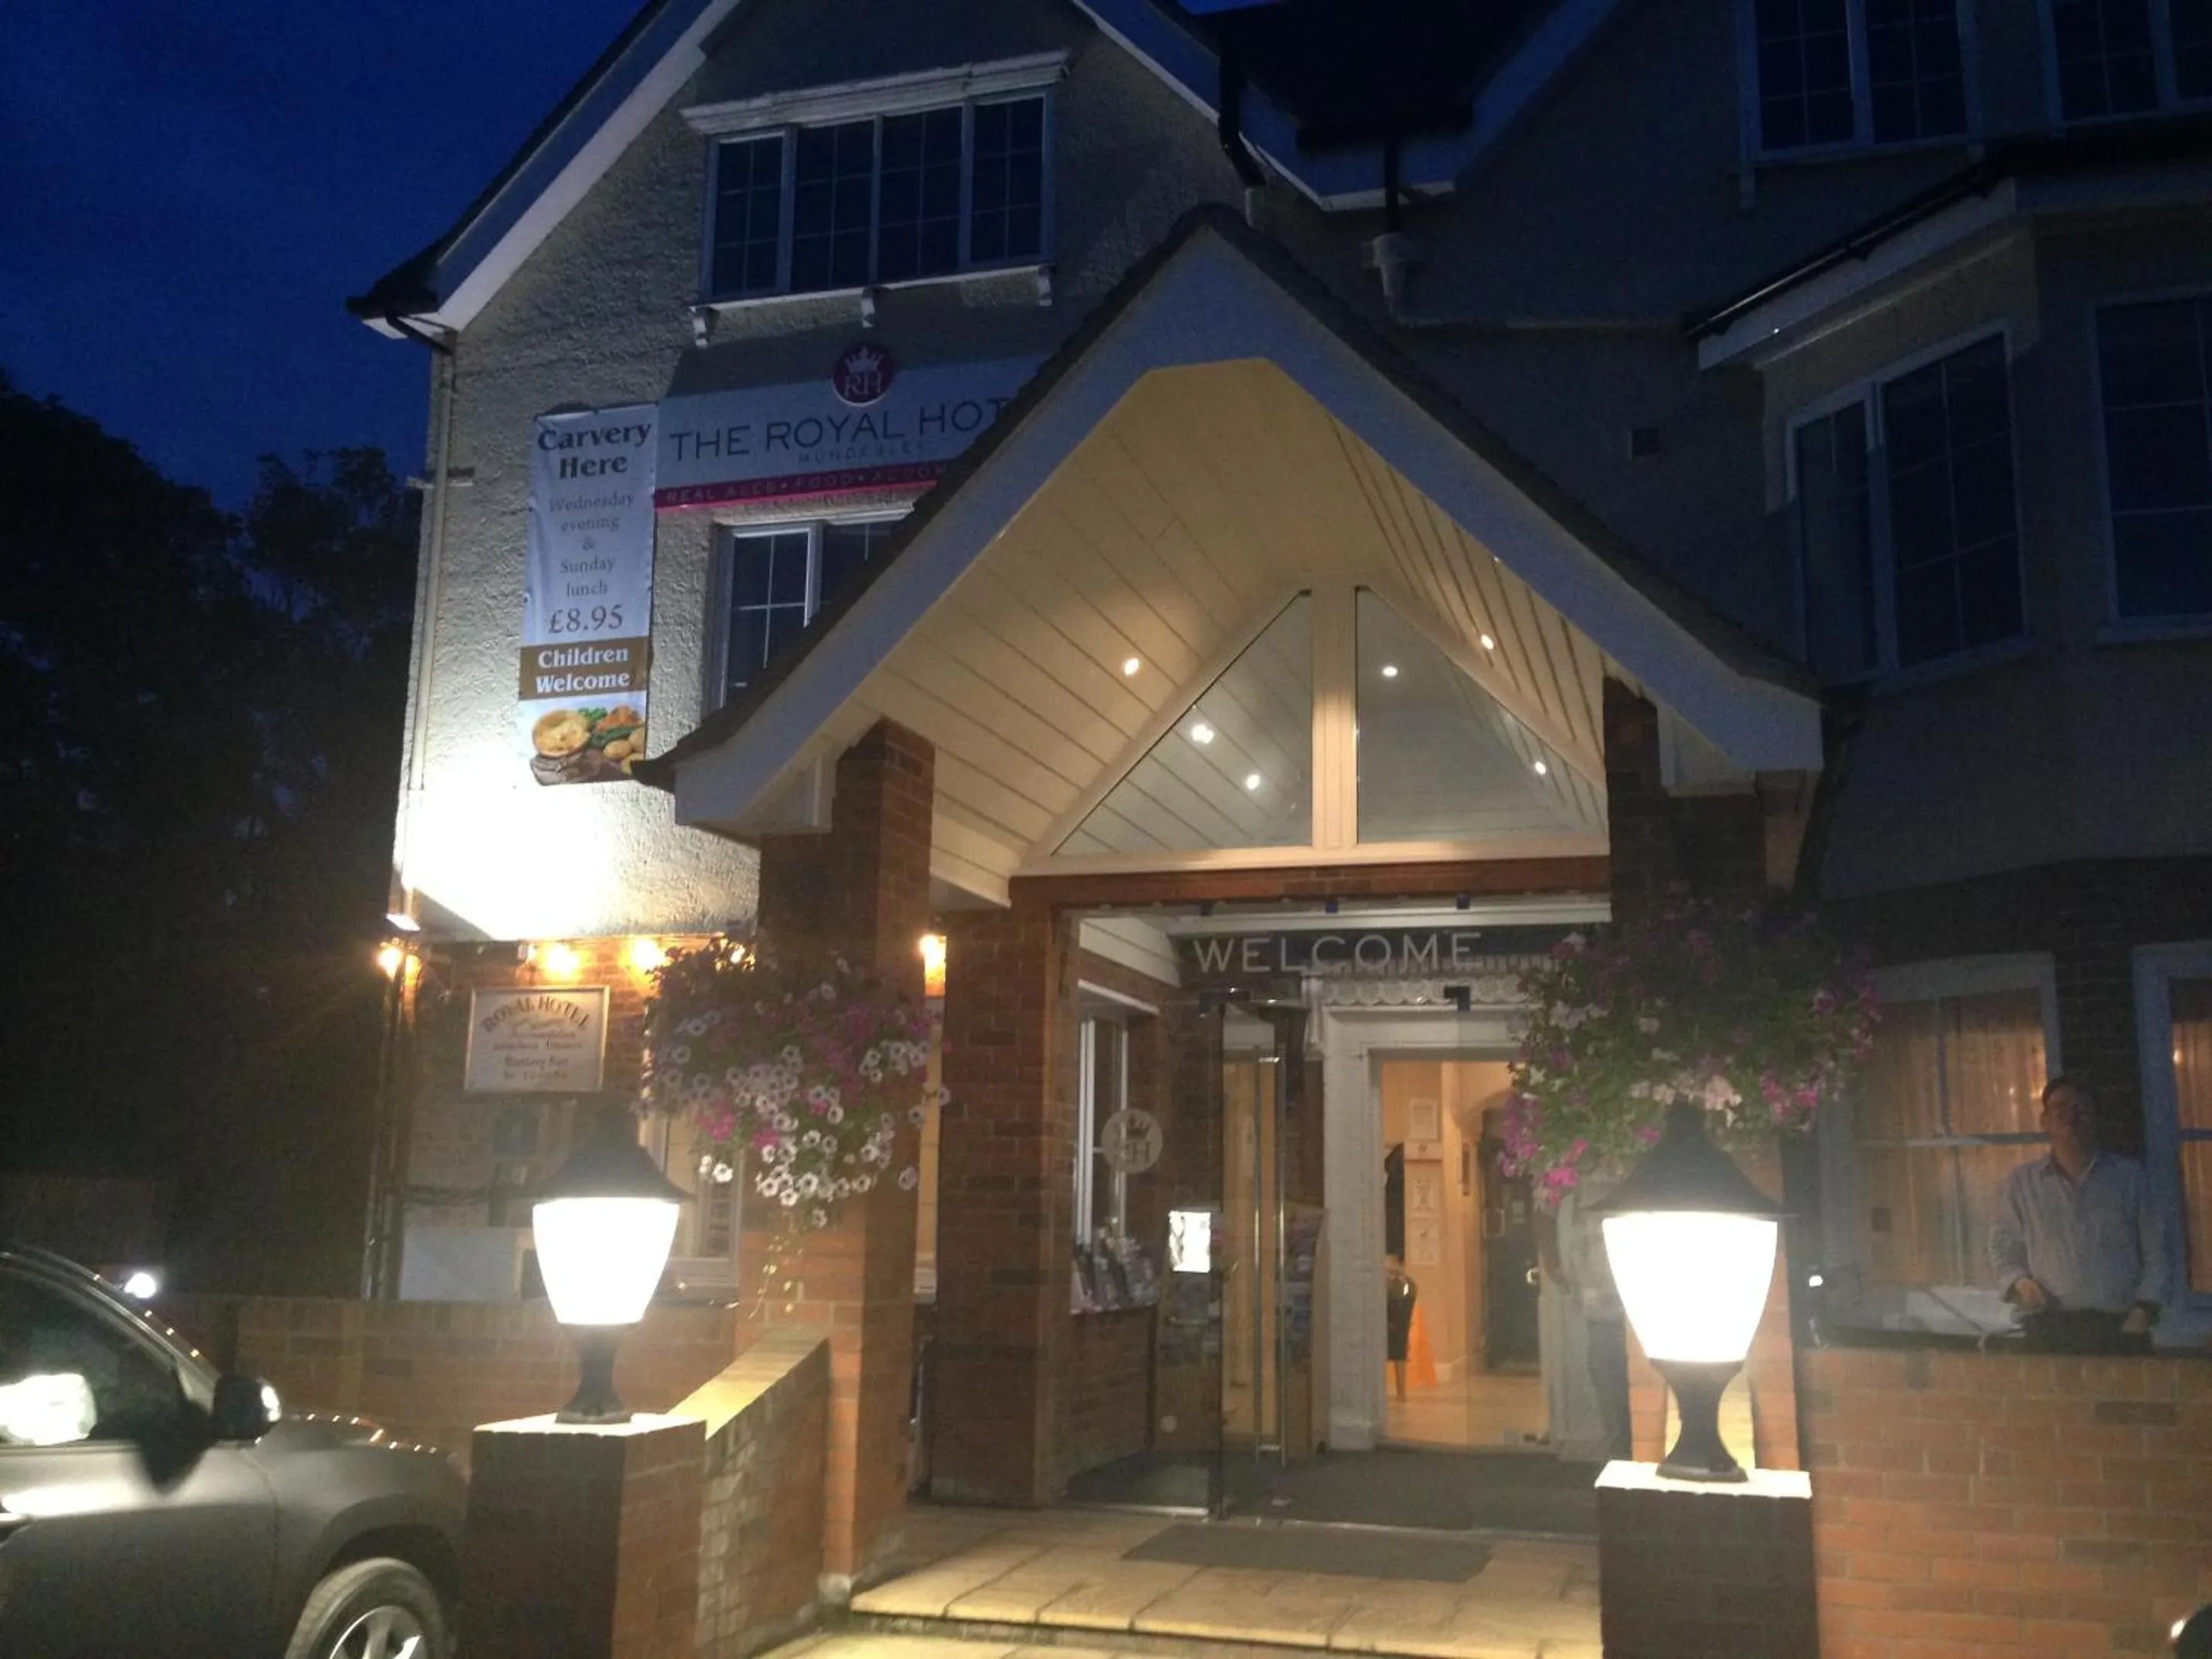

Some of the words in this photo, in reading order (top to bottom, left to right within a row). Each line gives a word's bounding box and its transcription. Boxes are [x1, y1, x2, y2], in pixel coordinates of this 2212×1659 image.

[537, 423, 652, 451] Carvery
[670, 425, 751, 461] THE
[766, 410, 904, 452] ROYAL
[559, 455, 628, 479] Here
[549, 491, 635, 513] Wednesday
[560, 517, 620, 532] evening
[560, 555, 616, 575] Sunday
[566, 579, 609, 598] lunch
[549, 603, 623, 634] £8.95
[537, 647, 629, 669] Children
[536, 671, 630, 694] Welcome
[1192, 931, 1484, 973] WELCOME
[481, 996, 532, 1033] ROYAL
